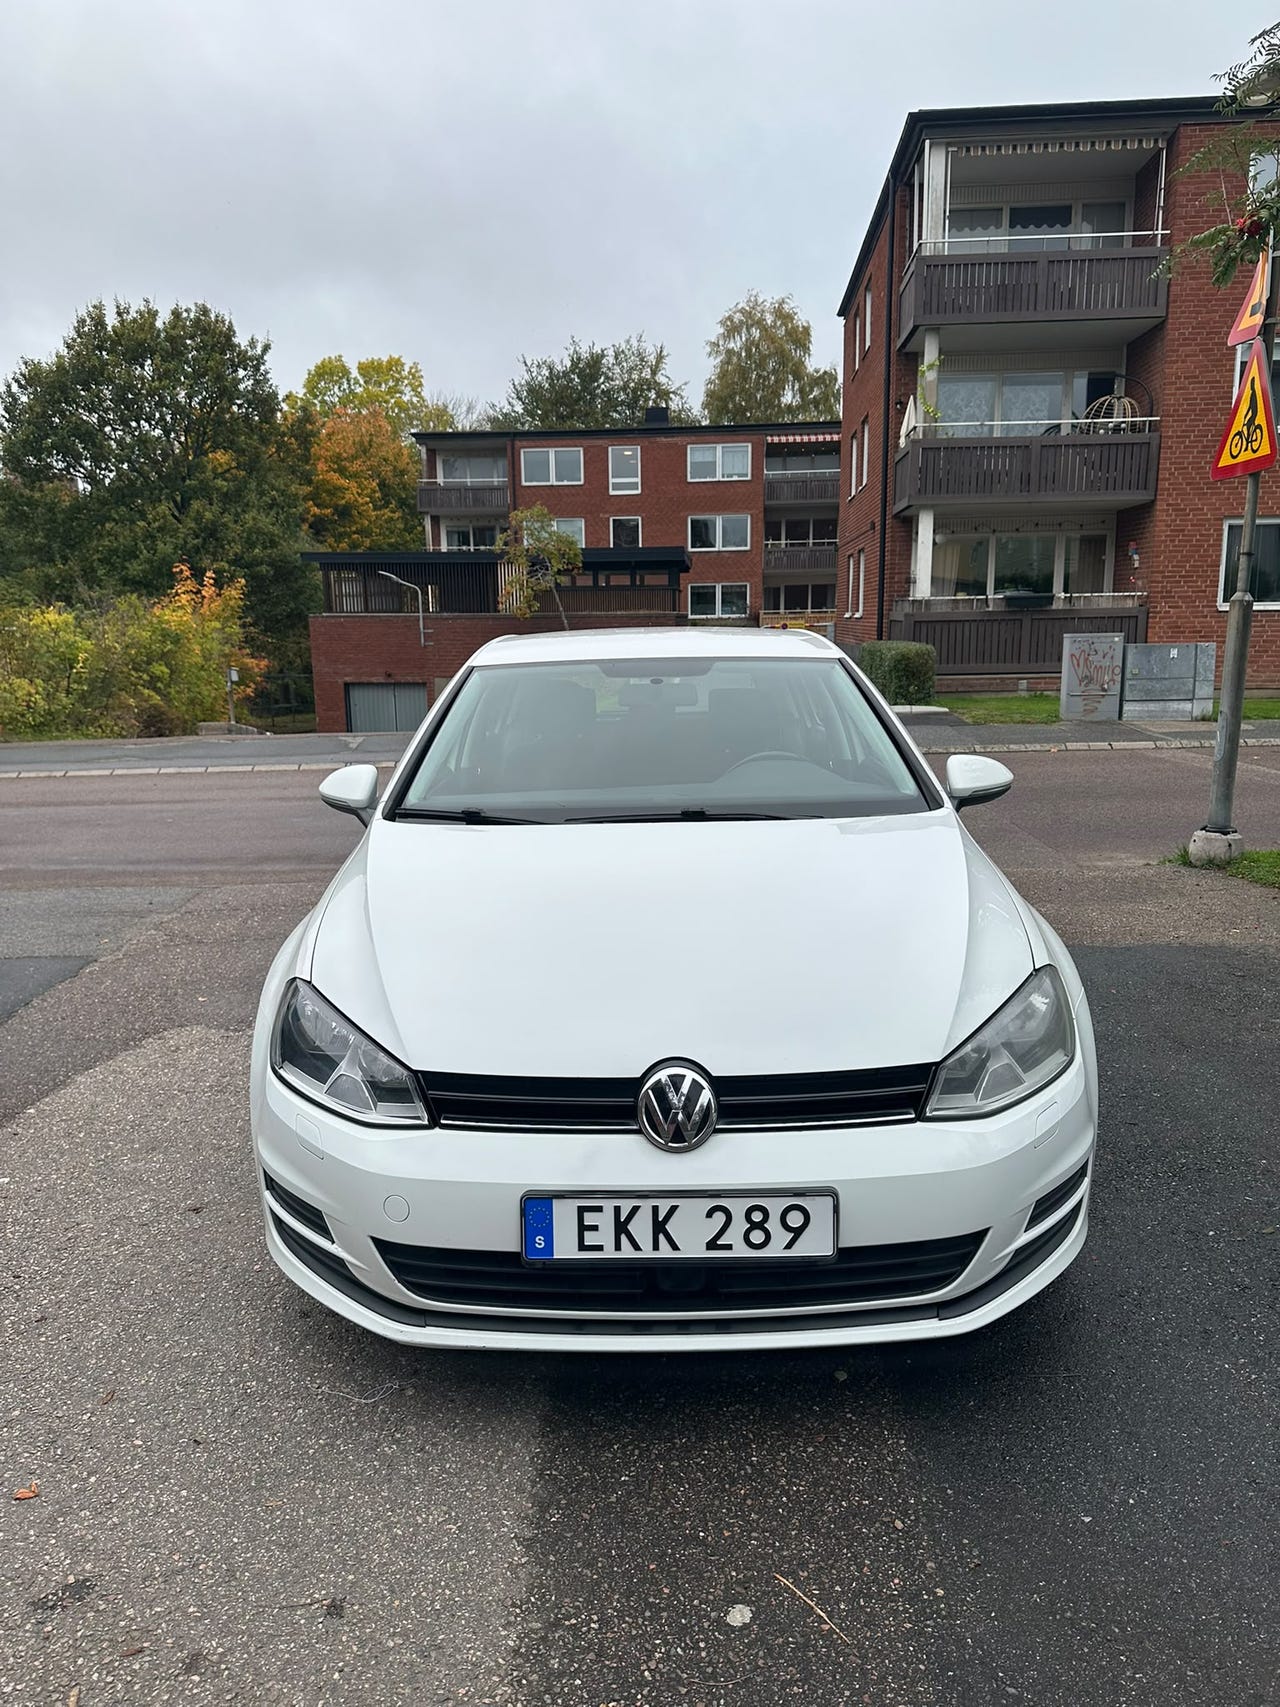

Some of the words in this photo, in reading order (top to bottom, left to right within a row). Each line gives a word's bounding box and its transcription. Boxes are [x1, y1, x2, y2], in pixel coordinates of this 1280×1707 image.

[642, 1069, 713, 1147] VW
[534, 1235, 546, 1249] S
[576, 1204, 681, 1252] EKK
[704, 1203, 811, 1251] 289
